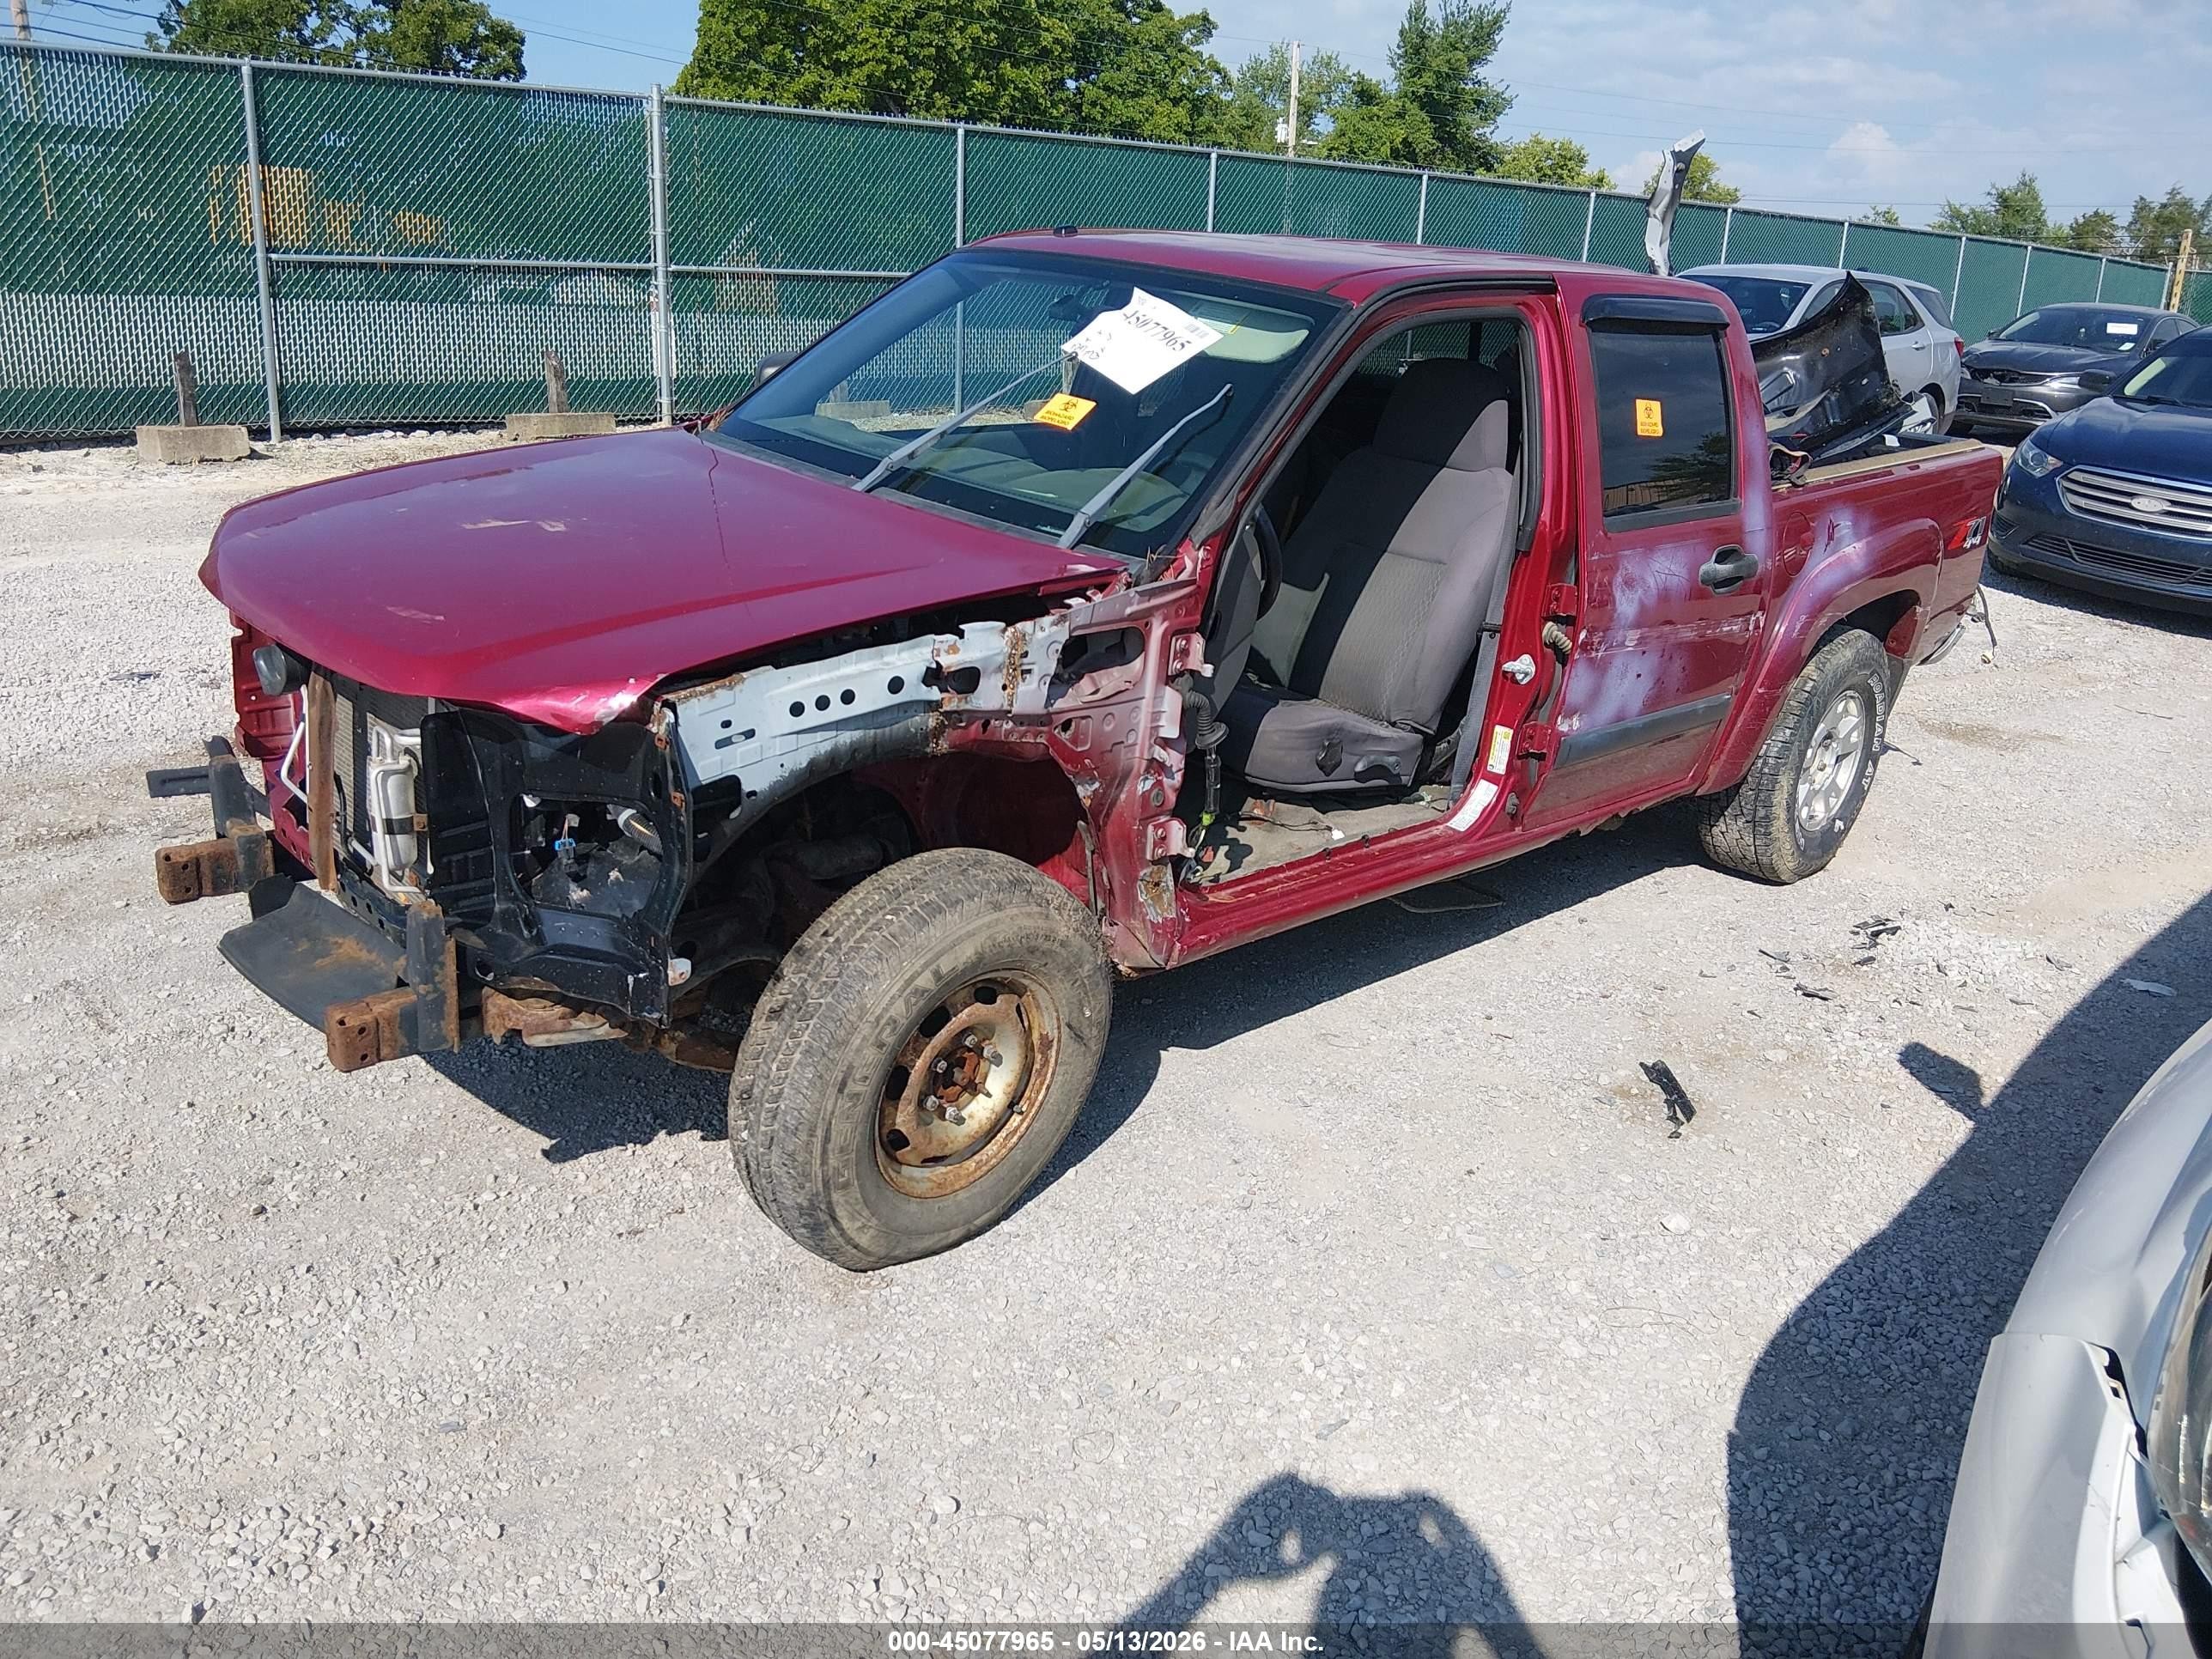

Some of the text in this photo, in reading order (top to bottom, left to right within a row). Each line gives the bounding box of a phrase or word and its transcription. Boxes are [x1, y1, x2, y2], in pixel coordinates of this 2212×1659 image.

[1122, 310, 1192, 351] 45077965
[1868, 673, 1885, 751] ROADIAN
[831, 963, 959, 1192] GENERAL
